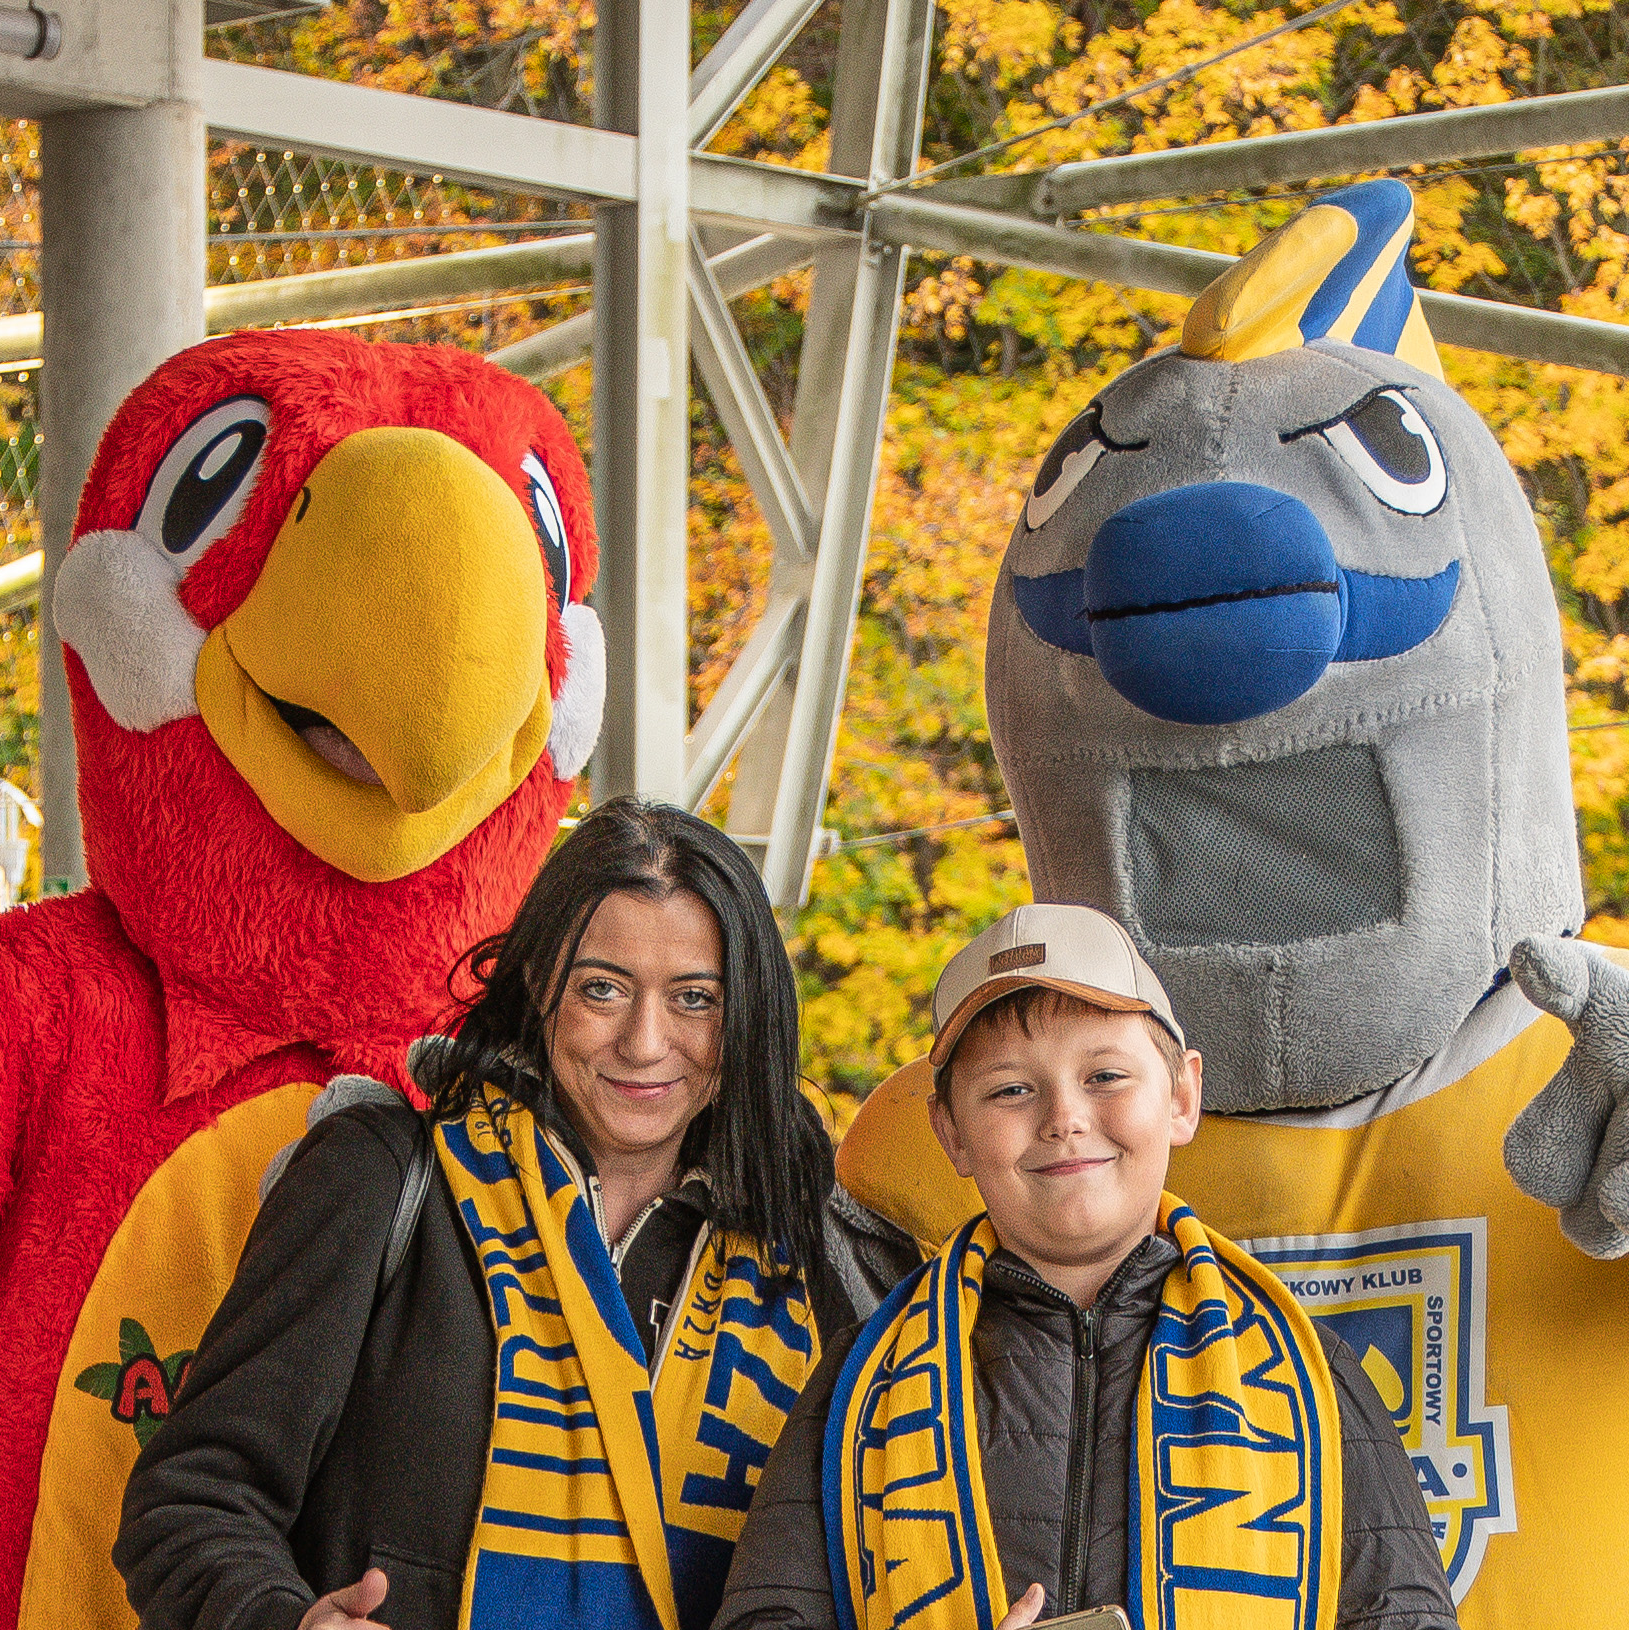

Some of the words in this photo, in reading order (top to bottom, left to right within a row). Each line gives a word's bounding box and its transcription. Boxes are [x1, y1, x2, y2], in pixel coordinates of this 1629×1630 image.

[1284, 1276, 1355, 1297] KOWY
[1362, 1267, 1423, 1291] KLUB
[1425, 1294, 1444, 1427] SPORTOWY
